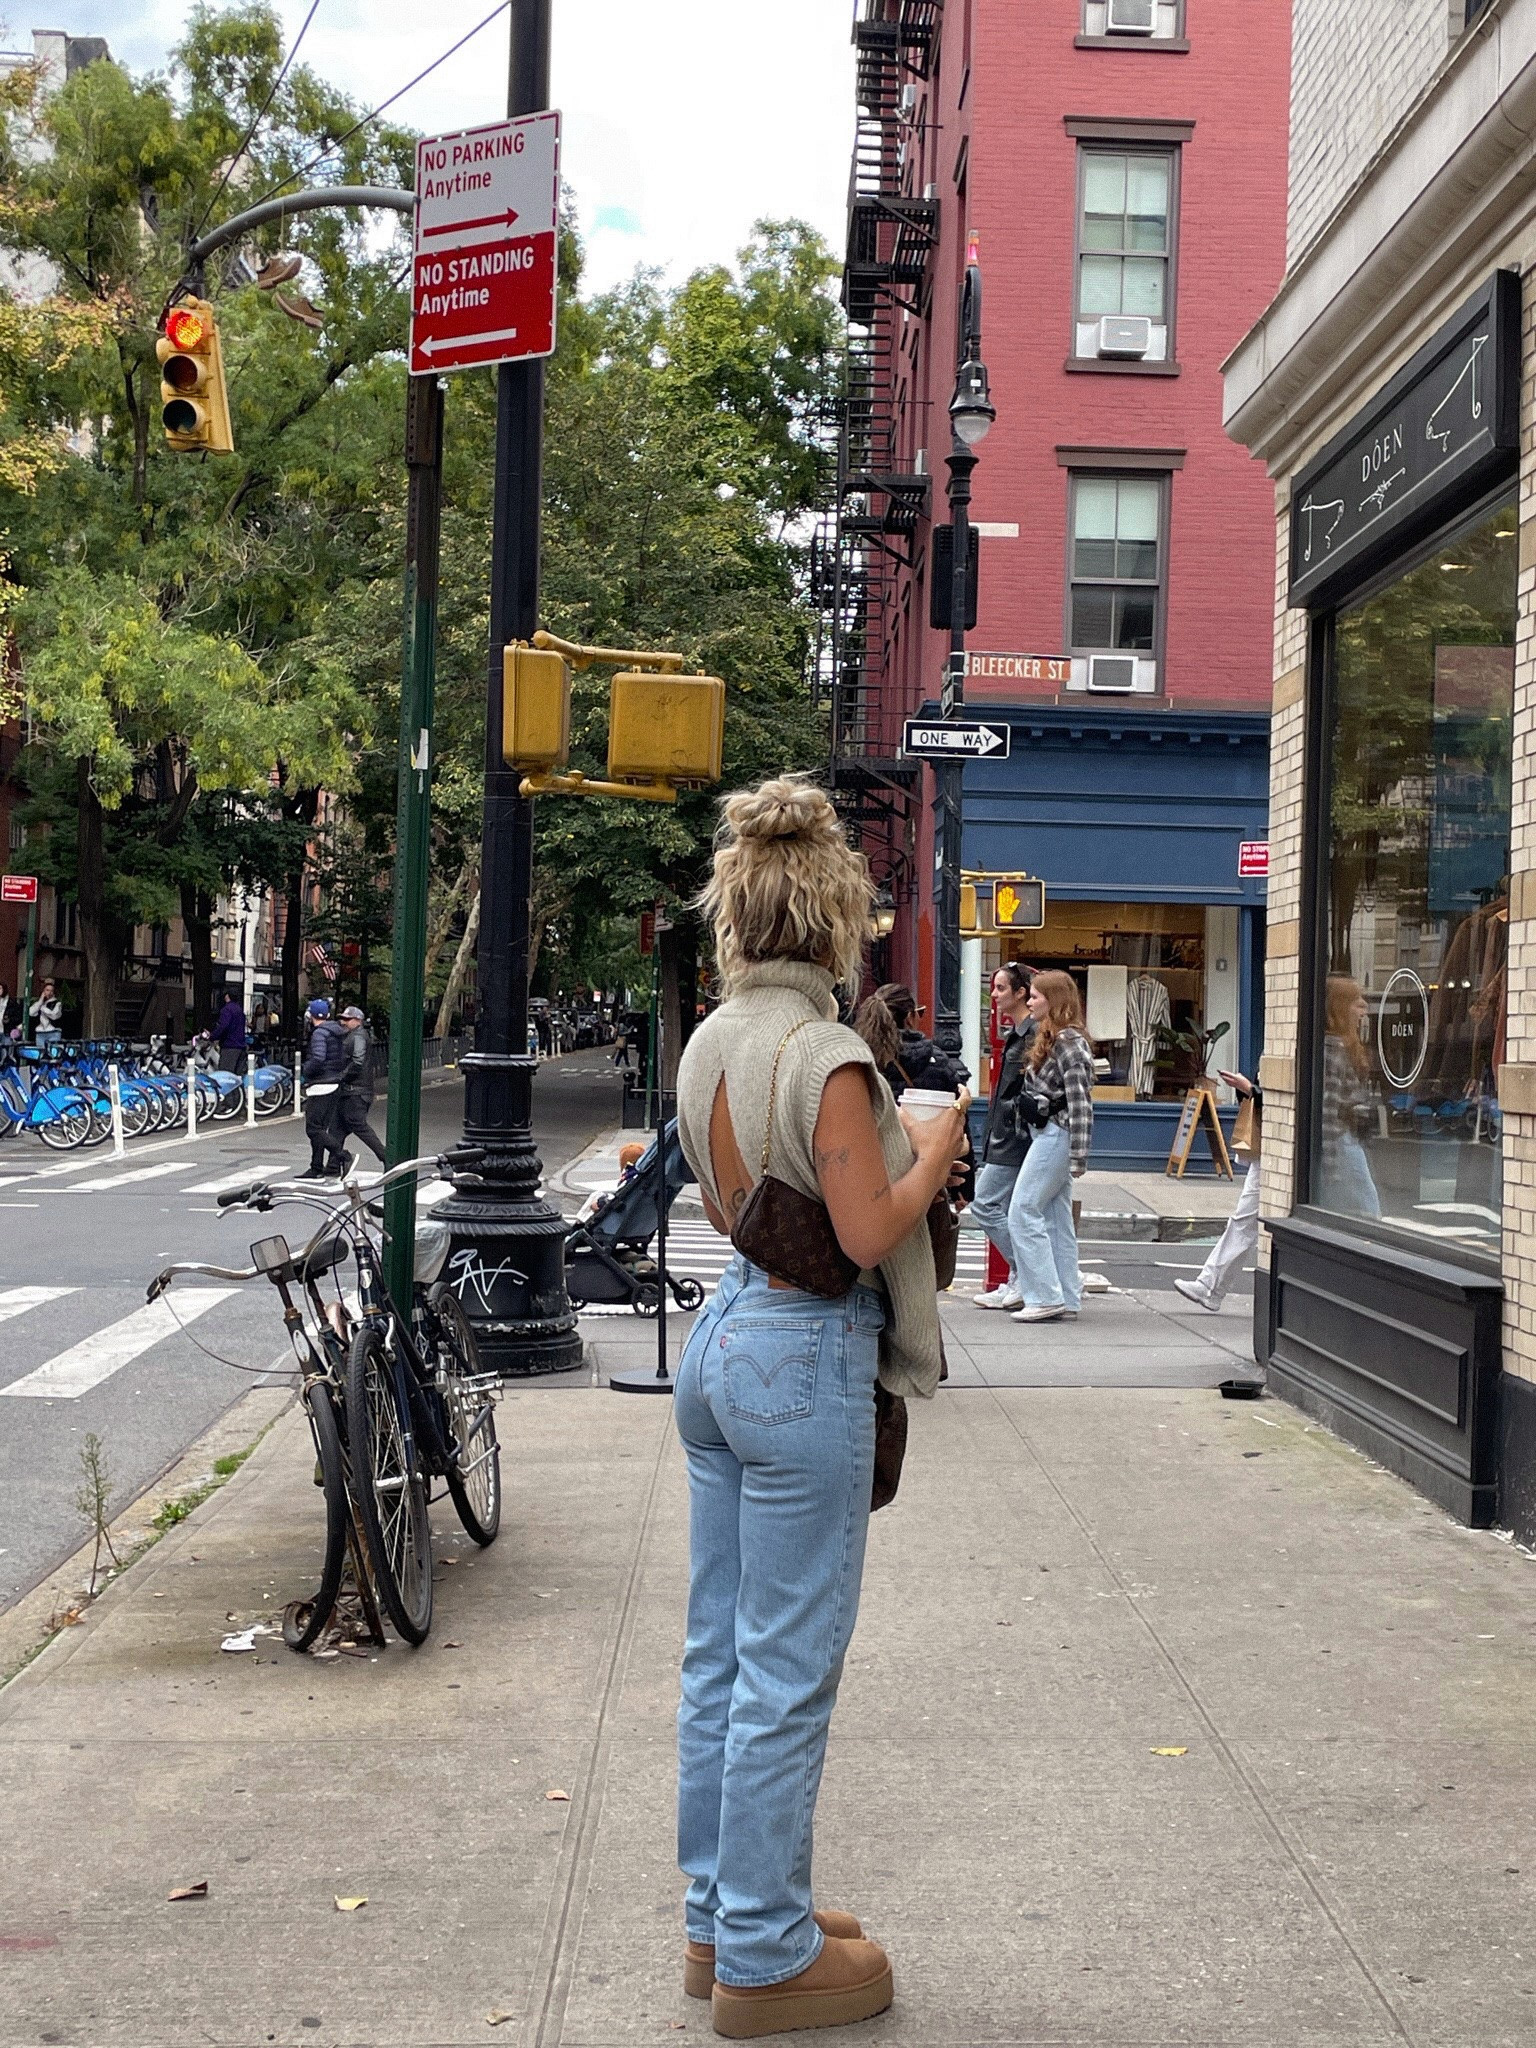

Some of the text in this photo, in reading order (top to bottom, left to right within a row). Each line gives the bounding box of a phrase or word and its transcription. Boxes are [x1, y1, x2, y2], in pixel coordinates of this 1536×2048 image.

[425, 132, 525, 172] NO PARKING
[424, 171, 492, 200] Anytime
[419, 246, 534, 287] NO STANDING
[419, 286, 490, 317] Anytime
[971, 656, 1065, 680] BLEECKER ST
[920, 731, 993, 747] ONE WAY
